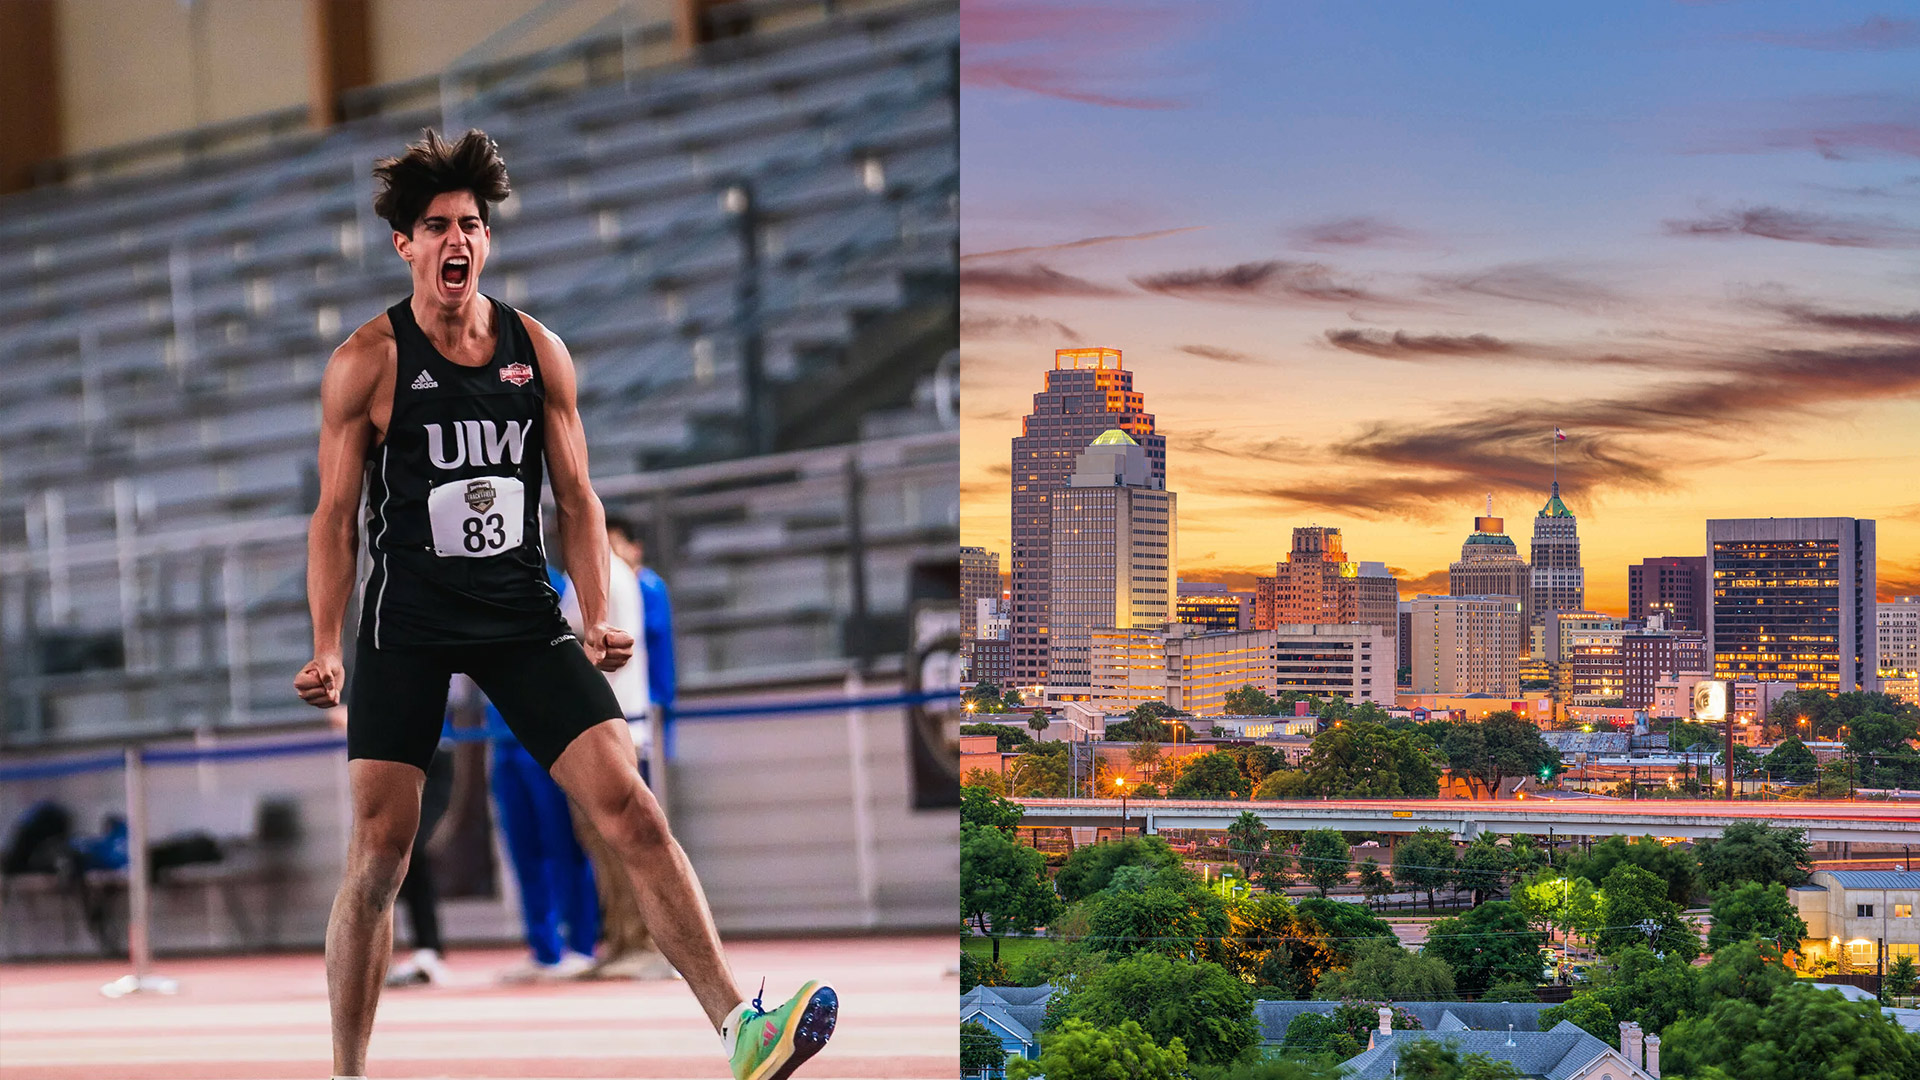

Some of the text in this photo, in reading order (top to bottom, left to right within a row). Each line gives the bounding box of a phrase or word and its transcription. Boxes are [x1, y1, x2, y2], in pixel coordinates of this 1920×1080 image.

[411, 381, 438, 390] adidas
[423, 419, 532, 470] UIW
[463, 513, 506, 553] 83
